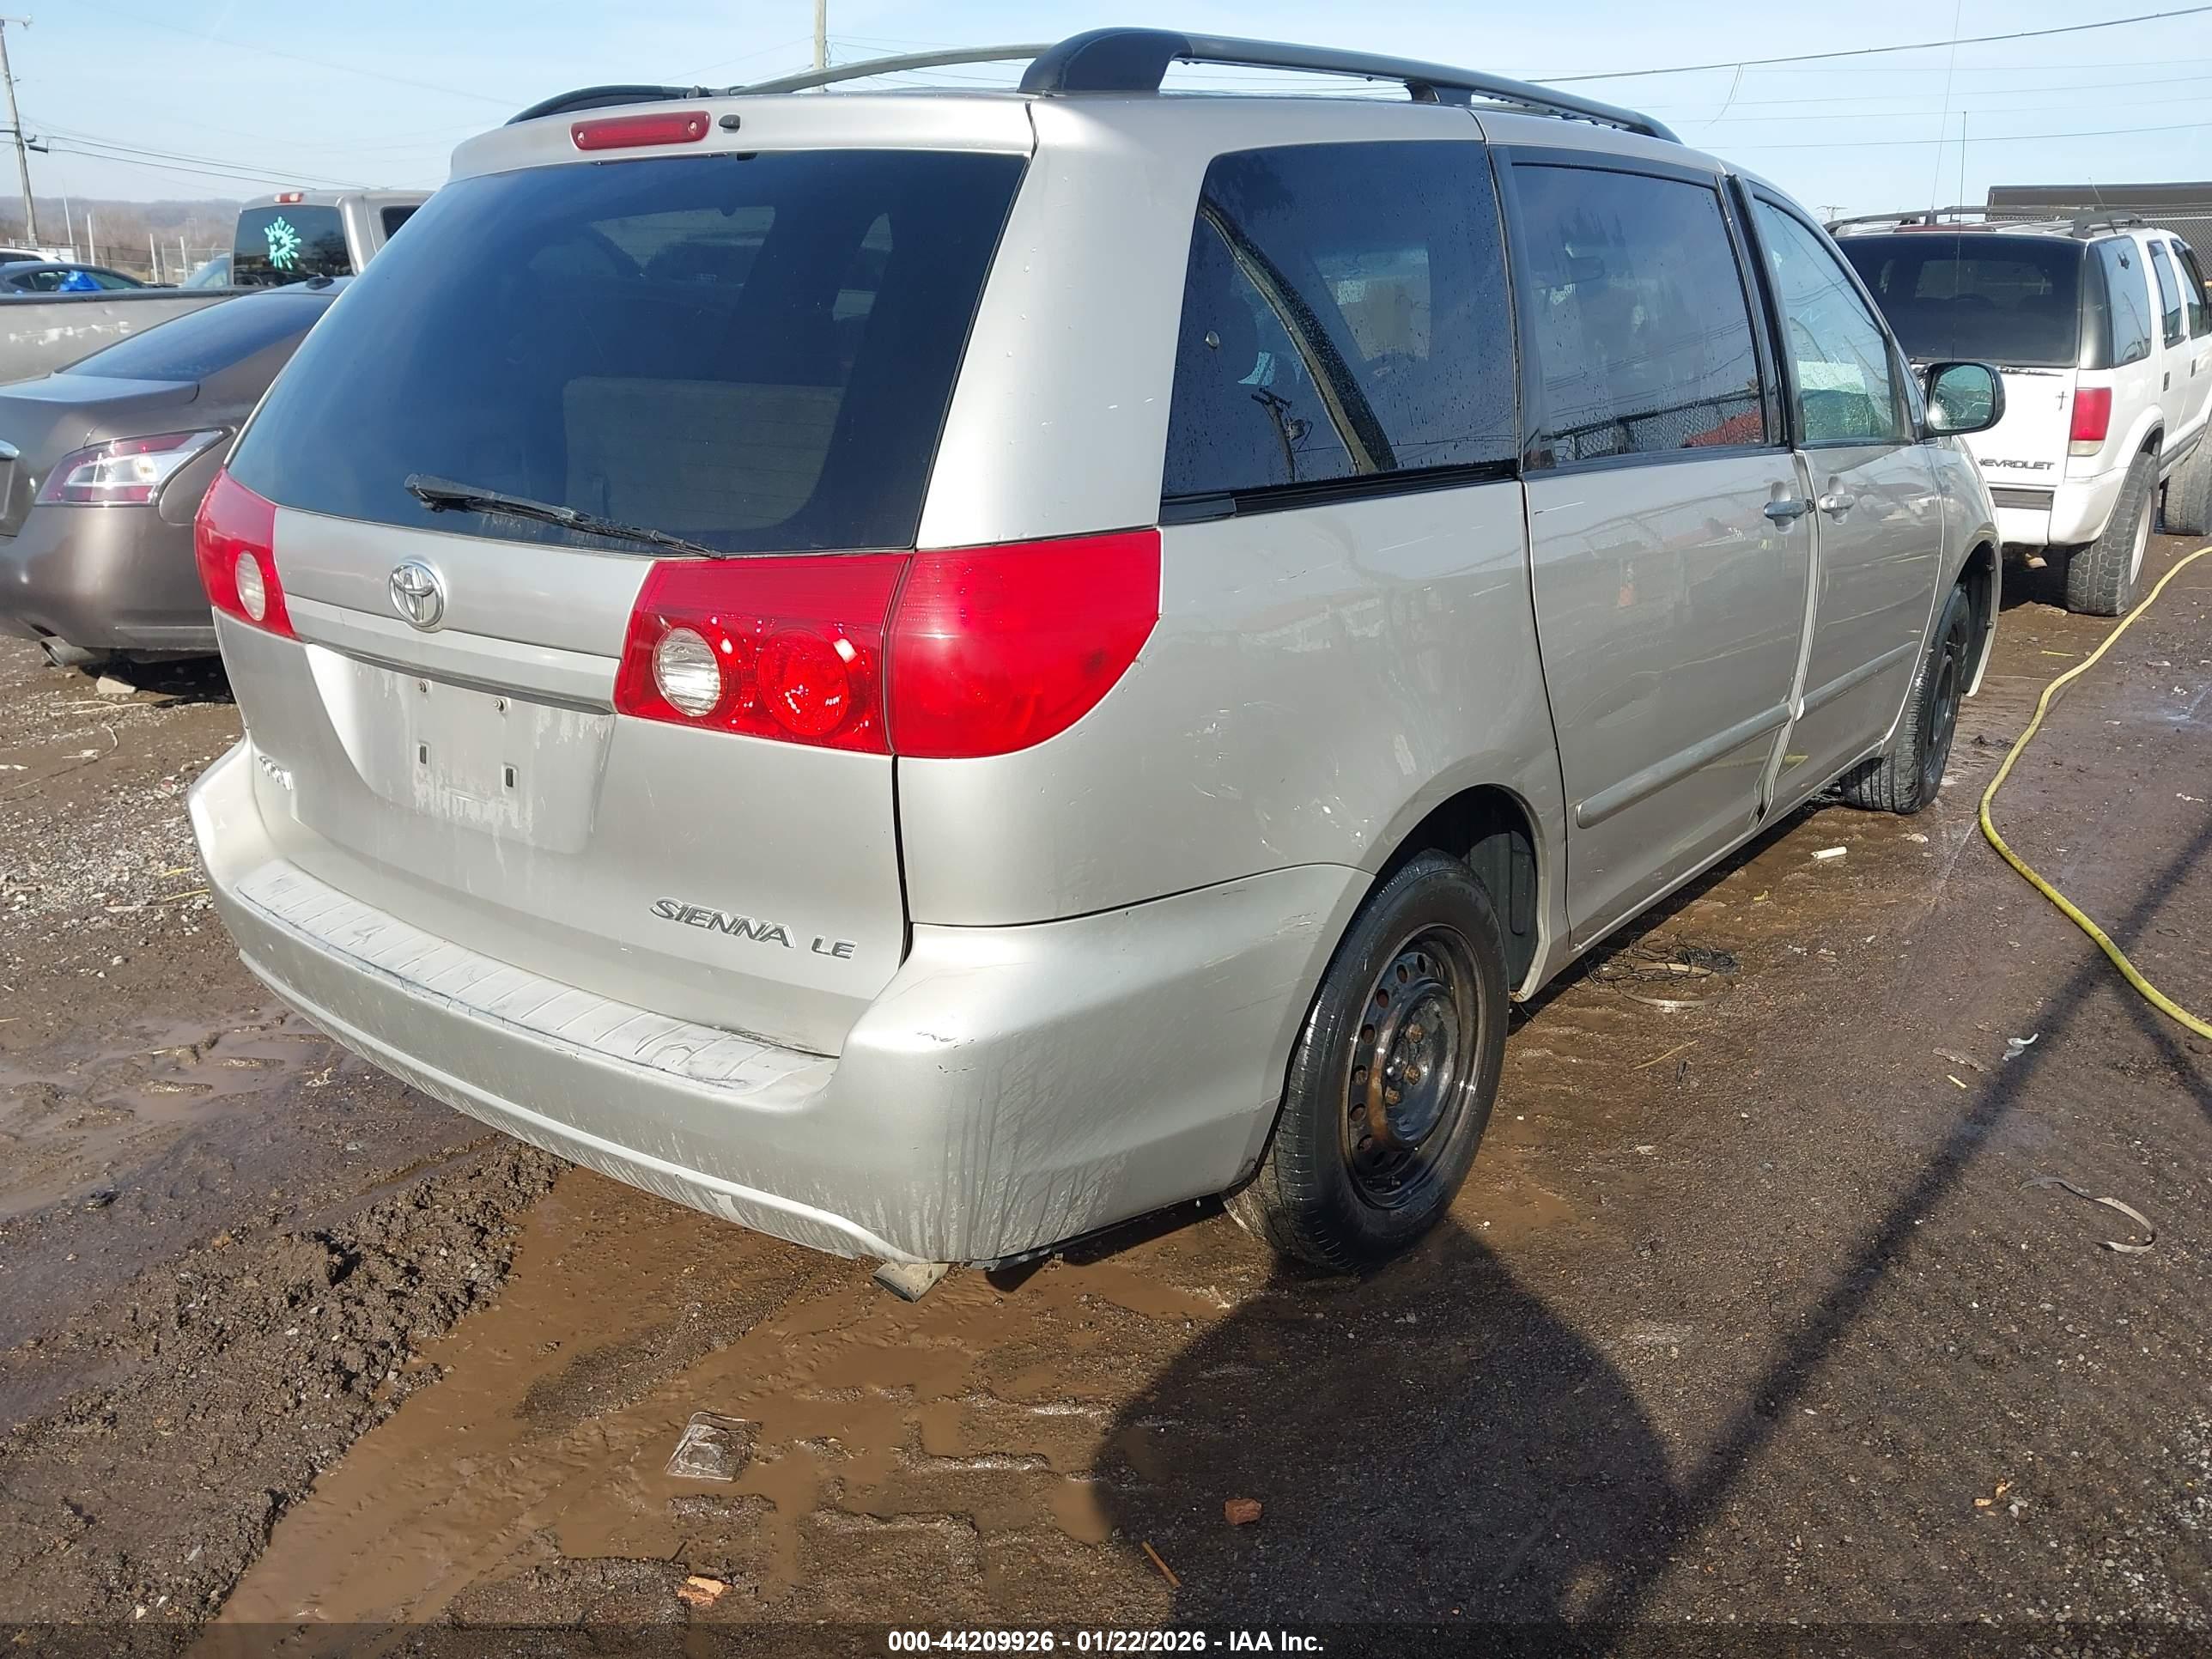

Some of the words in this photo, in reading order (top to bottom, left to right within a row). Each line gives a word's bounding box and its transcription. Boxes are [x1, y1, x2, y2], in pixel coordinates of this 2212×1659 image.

[1978, 458, 2055, 470] HEVROLET
[649, 897, 796, 949] SIENNA
[811, 935, 857, 959] LE
